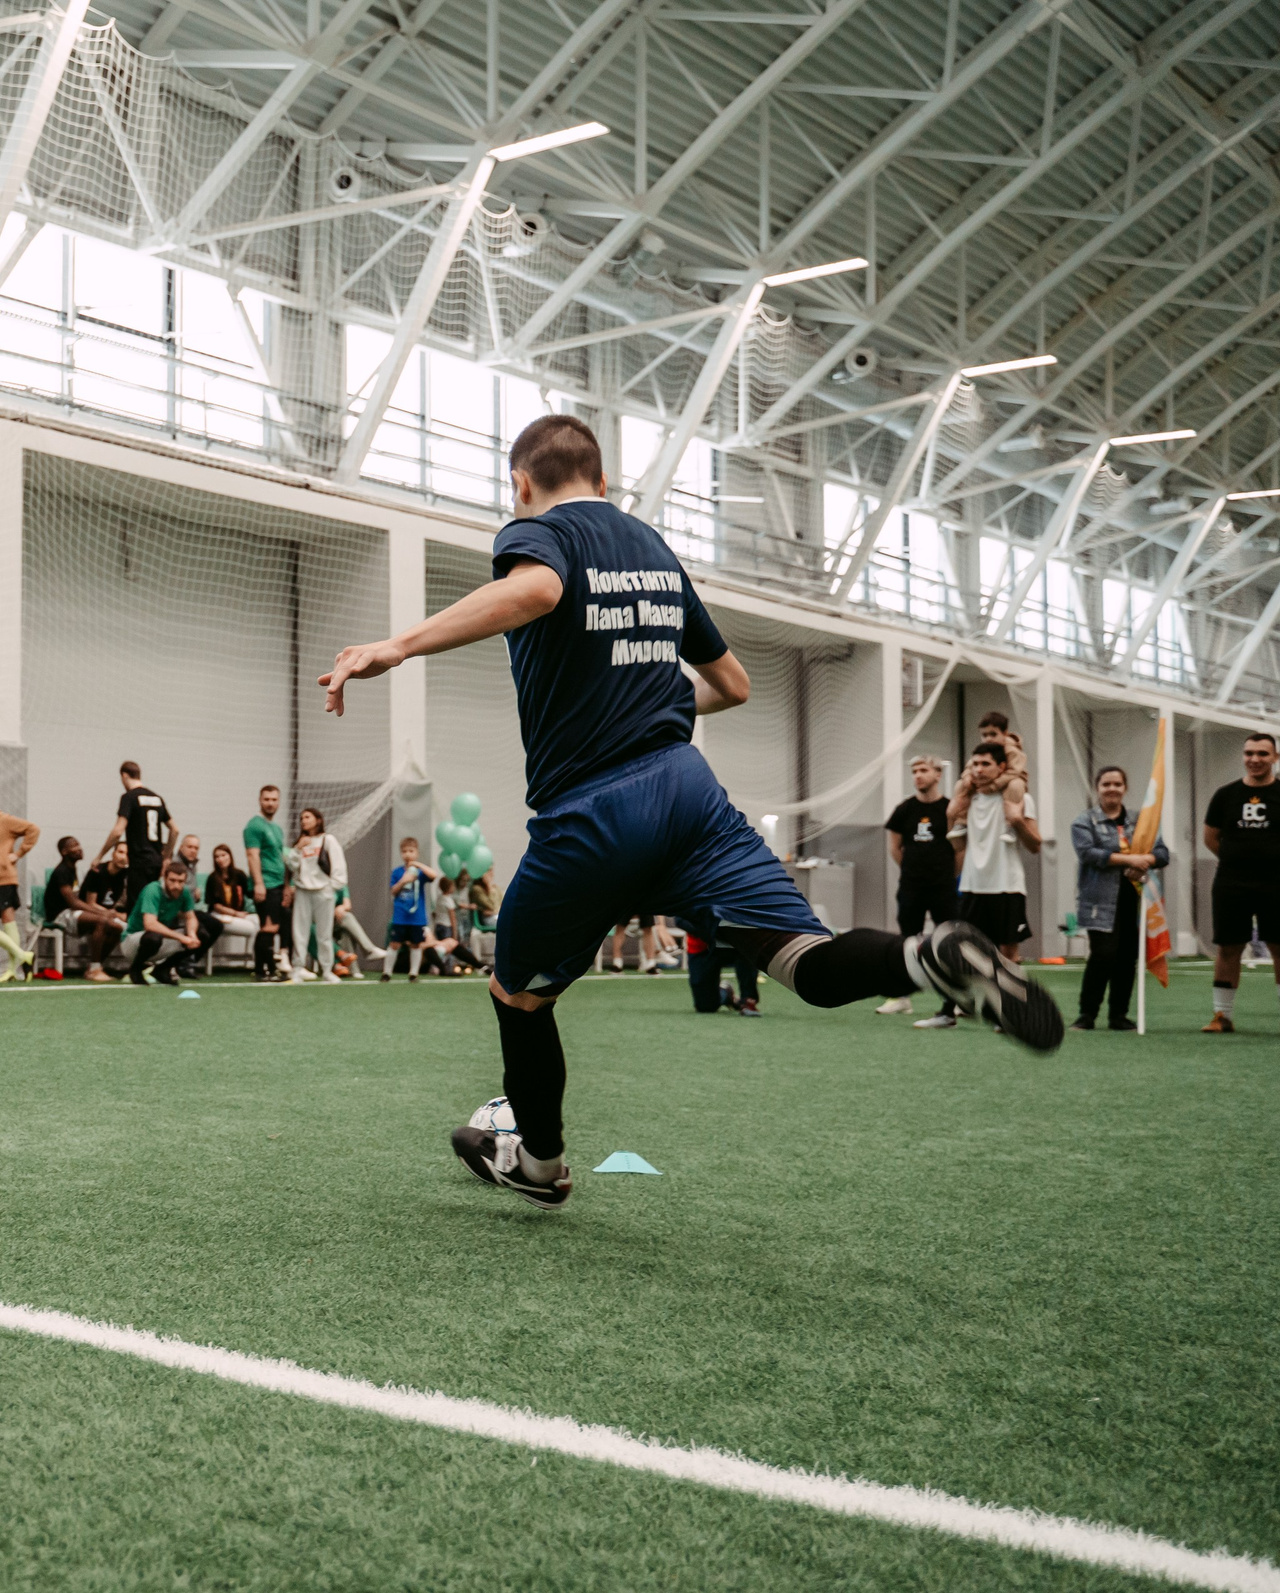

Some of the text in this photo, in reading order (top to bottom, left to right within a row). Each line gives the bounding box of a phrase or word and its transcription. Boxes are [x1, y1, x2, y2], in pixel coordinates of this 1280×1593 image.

[586, 568, 682, 594] Константин
[586, 603, 635, 631] Папа
[611, 638, 677, 666] Мирона
